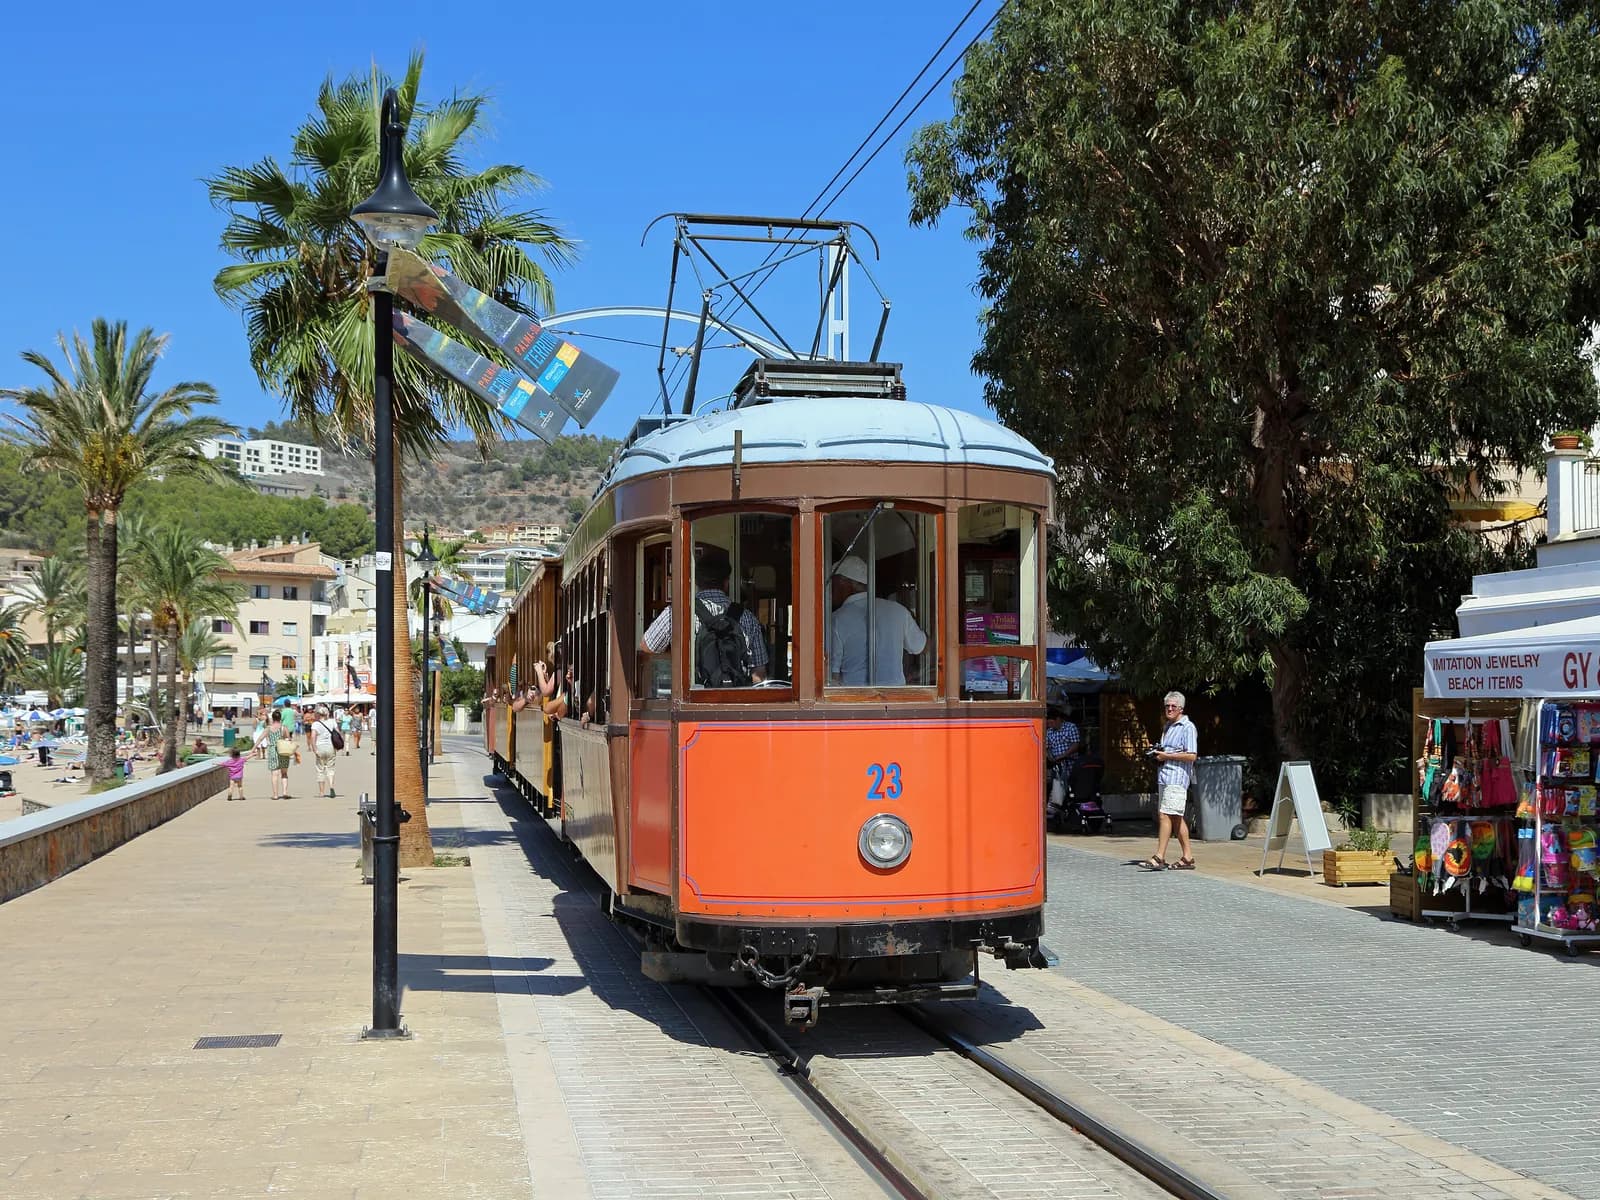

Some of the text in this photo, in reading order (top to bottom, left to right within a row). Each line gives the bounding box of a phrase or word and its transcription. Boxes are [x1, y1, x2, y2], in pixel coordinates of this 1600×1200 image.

[1433, 653, 1540, 671] IMITATION JEWELRY
[1563, 651, 1592, 689] GY
[1448, 675, 1524, 690] BEACH ITEMS
[866, 762, 903, 800] 23
